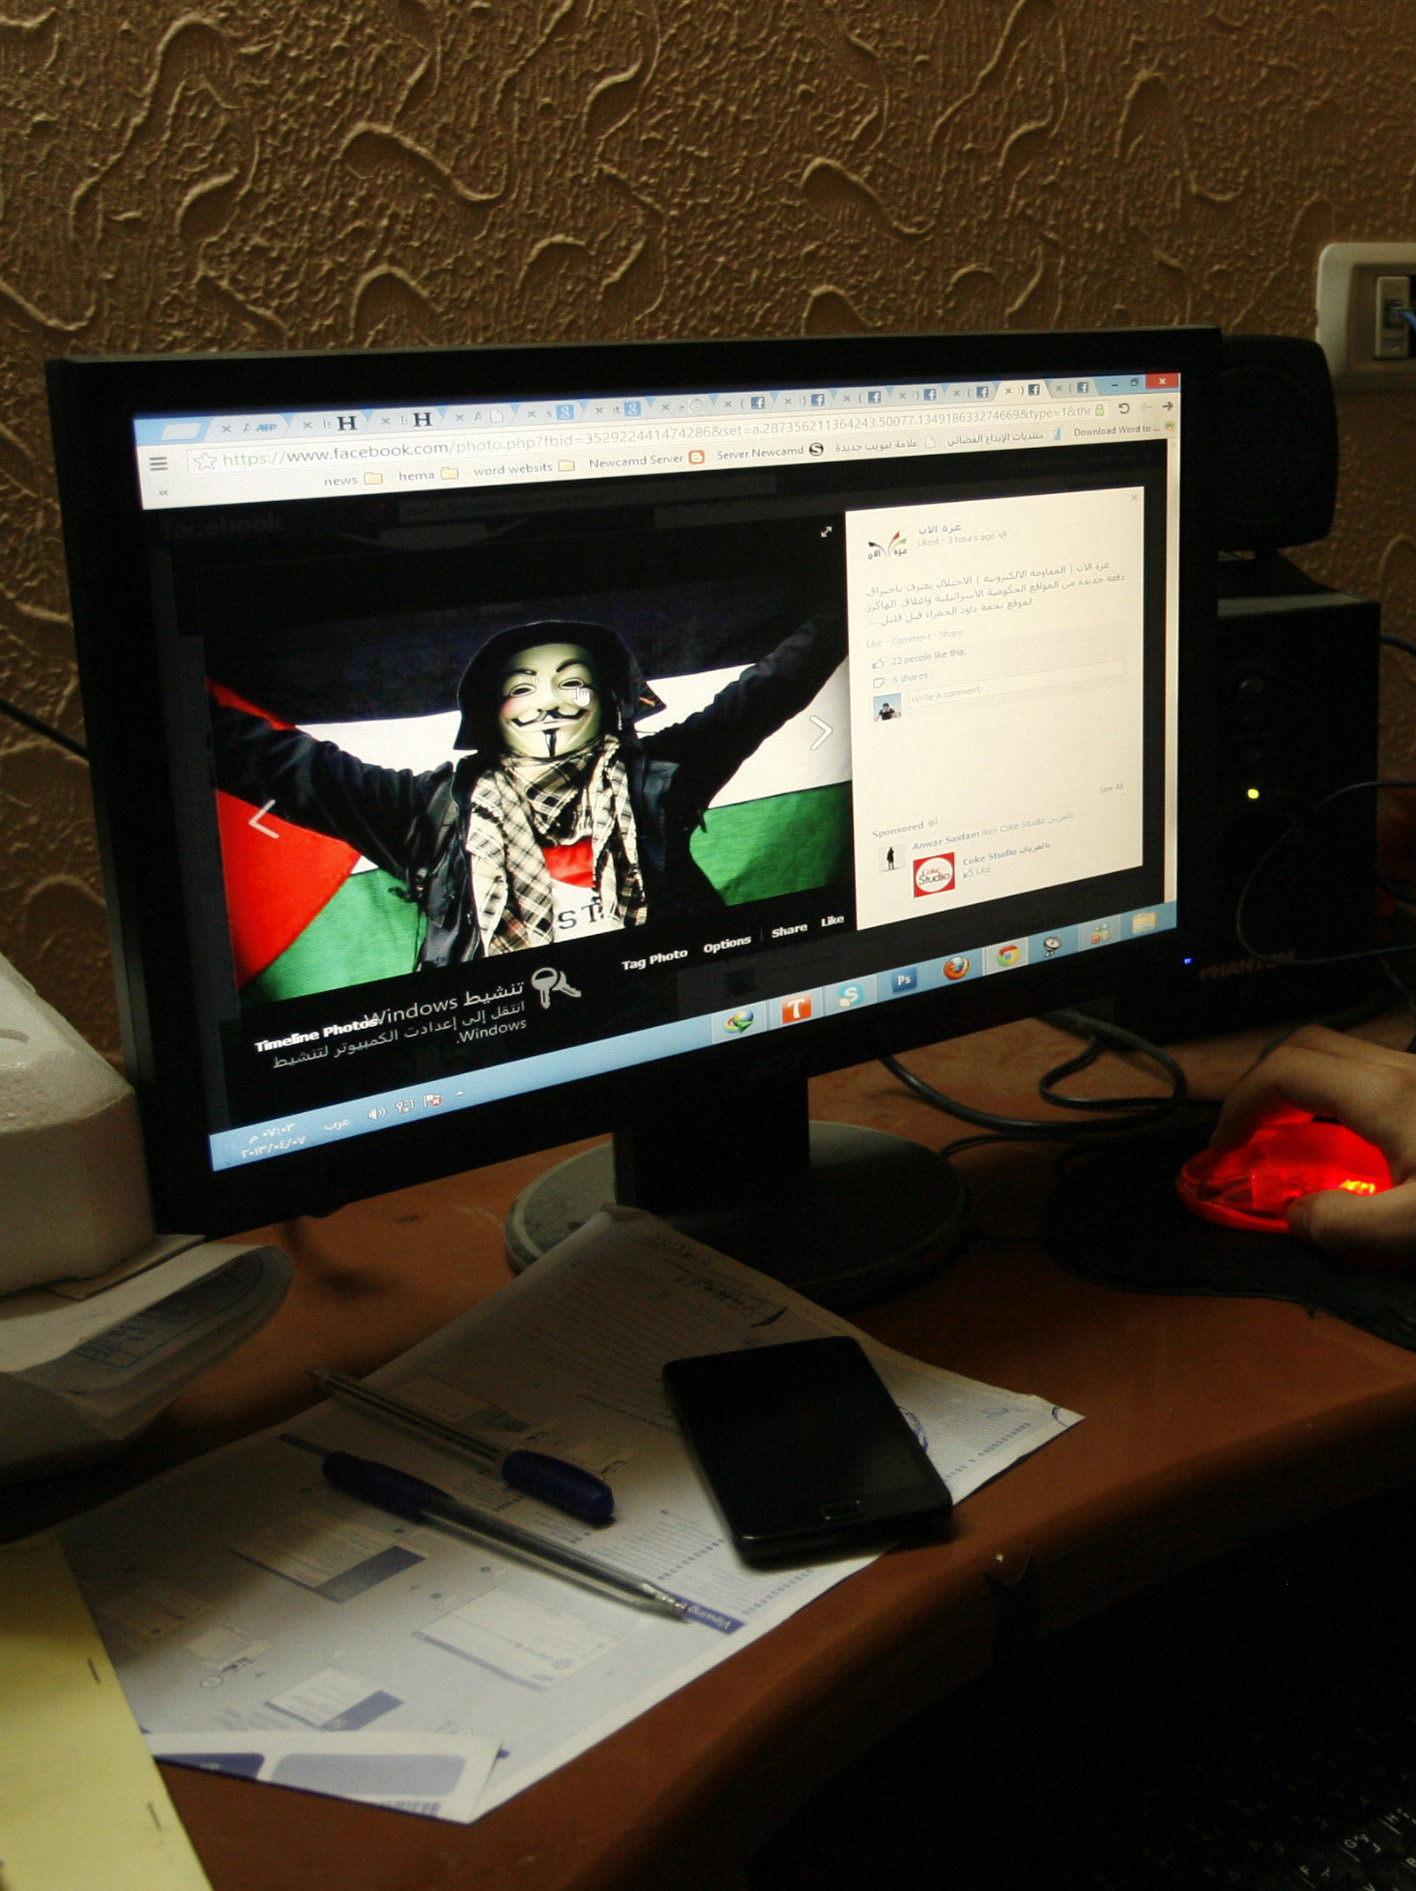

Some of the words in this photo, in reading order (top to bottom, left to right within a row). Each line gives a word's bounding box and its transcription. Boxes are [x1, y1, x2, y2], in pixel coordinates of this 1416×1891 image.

[337, 415, 357, 431] H
[412, 411, 432, 428] H
[1074, 425, 1116, 437] Download
[1118, 423, 1141, 434] Word
[589, 455, 648, 470] Newcamd
[650, 453, 684, 466] Server
[716, 450, 750, 462] Server
[752, 445, 804, 459] Newcamd
[399, 470, 435, 482] hema
[473, 464, 505, 477] word
[509, 461, 553, 475] websits
[324, 475, 358, 487] news
[872, 820, 925, 839] Sponsored
[911, 838, 944, 851] Anwar
[962, 855, 986, 867] Coke
[988, 848, 1017, 862] Studio
[918, 872, 951, 887] Studio
[821, 914, 845, 928] Like
[771, 923, 808, 939] Share
[703, 935, 752, 954] Options
[621, 958, 647, 971] Tag
[649, 949, 688, 965] Photo
[463, 981, 525, 1007] تنشيط
[364, 997, 458, 1026] Windows
[461, 1009, 486, 1026] إلى
[490, 1001, 525, 1020] انتقل
[254, 1030, 320, 1053] Timeline
[322, 1018, 380, 1039] Photos
[333, 1029, 398, 1058] الكمبيوتر
[272, 1045, 329, 1069] لتنشيط
